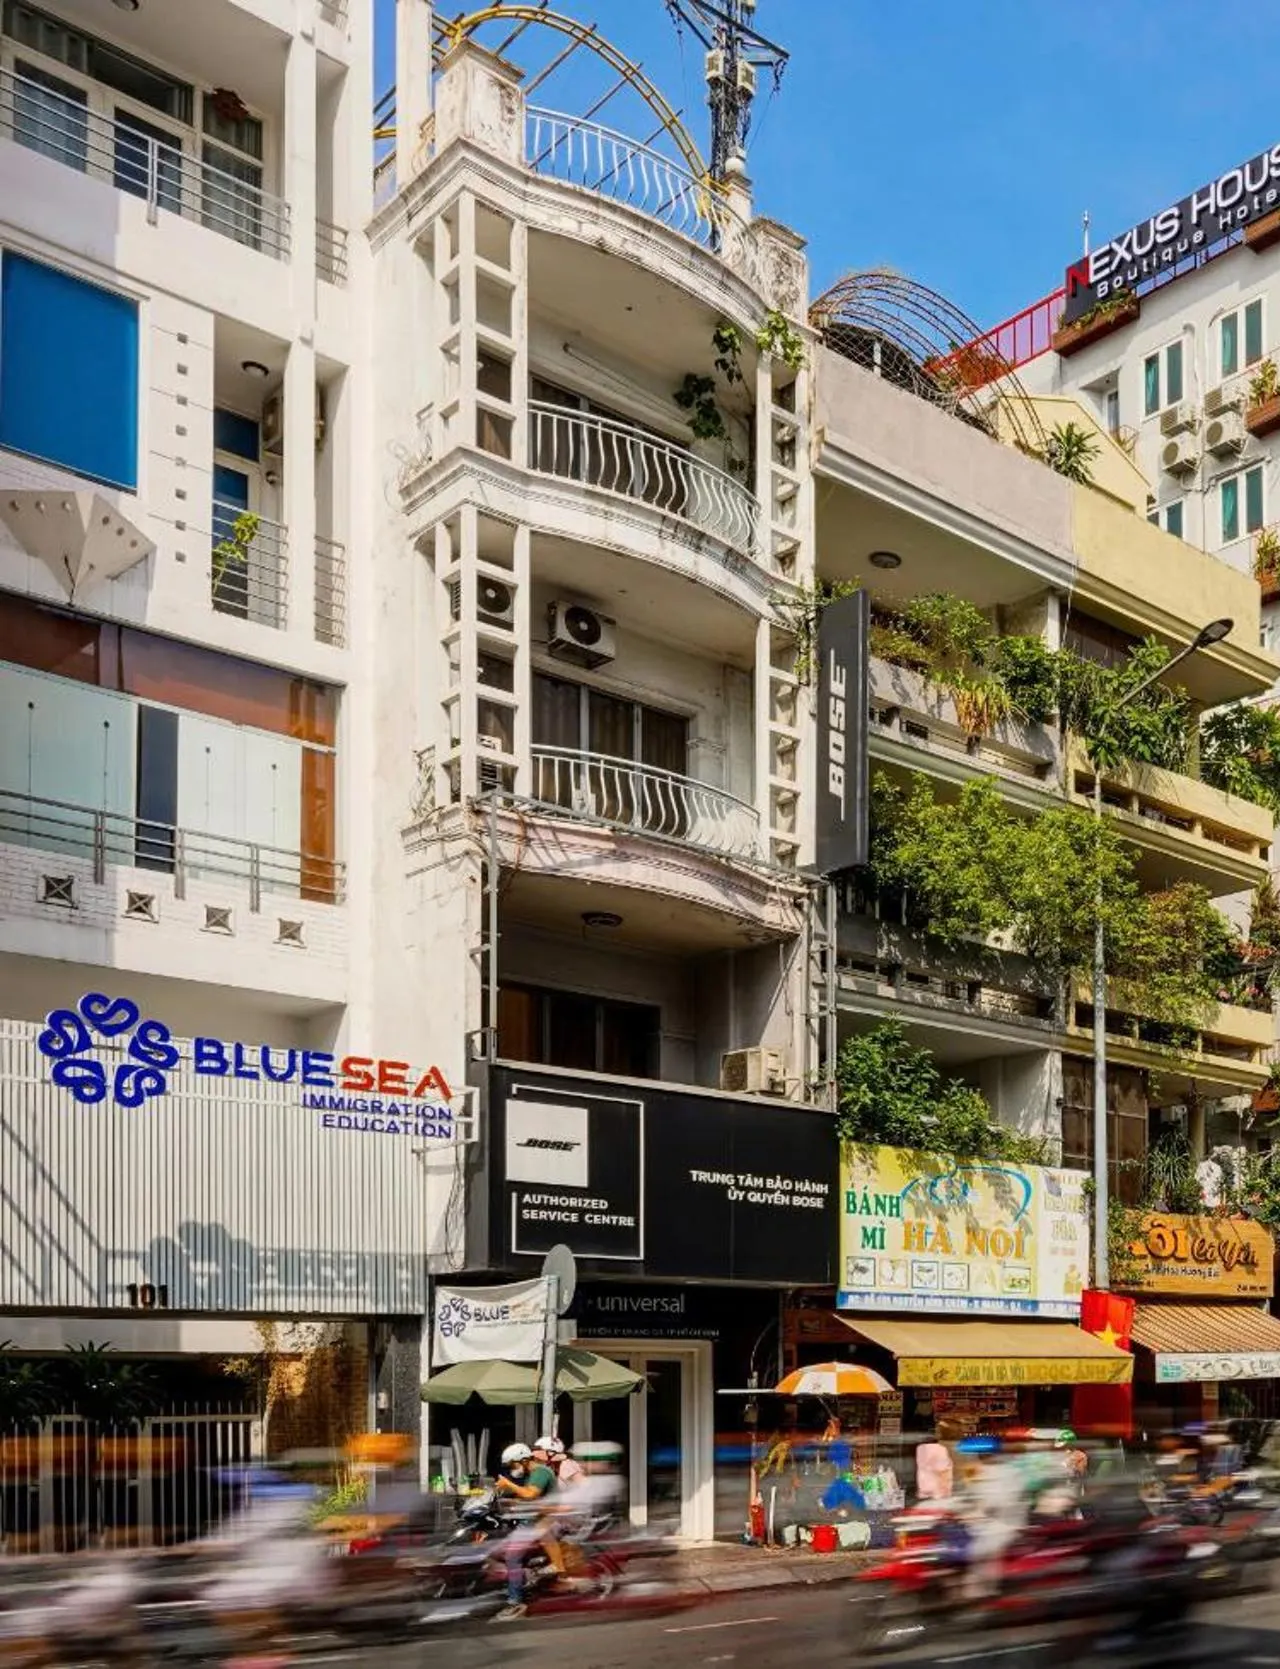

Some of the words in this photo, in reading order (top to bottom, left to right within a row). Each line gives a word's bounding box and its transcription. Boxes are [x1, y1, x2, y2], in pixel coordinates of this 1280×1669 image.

[1066, 206, 1181, 296] NEXUS
[1096, 230, 1205, 298] Boutique
[828, 647, 847, 822] BOSE
[302, 1092, 452, 1121] IMMIGRATION
[321, 1112, 452, 1140] EDUCATION
[515, 1137, 581, 1152] BOSE
[690, 1169, 736, 1185] TRUNG
[737, 1172, 764, 1188] TÂM
[766, 1174, 793, 1191] BẢO
[794, 1178, 829, 1195] HÀNH
[521, 1192, 609, 1210] AUTHORIZED
[792, 1195, 825, 1209] BOSE
[845, 1185, 902, 1218] BÁNH
[521, 1208, 580, 1224] SERVICE
[584, 1213, 636, 1227] CENTRE
[126, 1283, 168, 1306] 101
[597, 1292, 686, 1314] universal
[473, 1304, 510, 1323] BLUE
